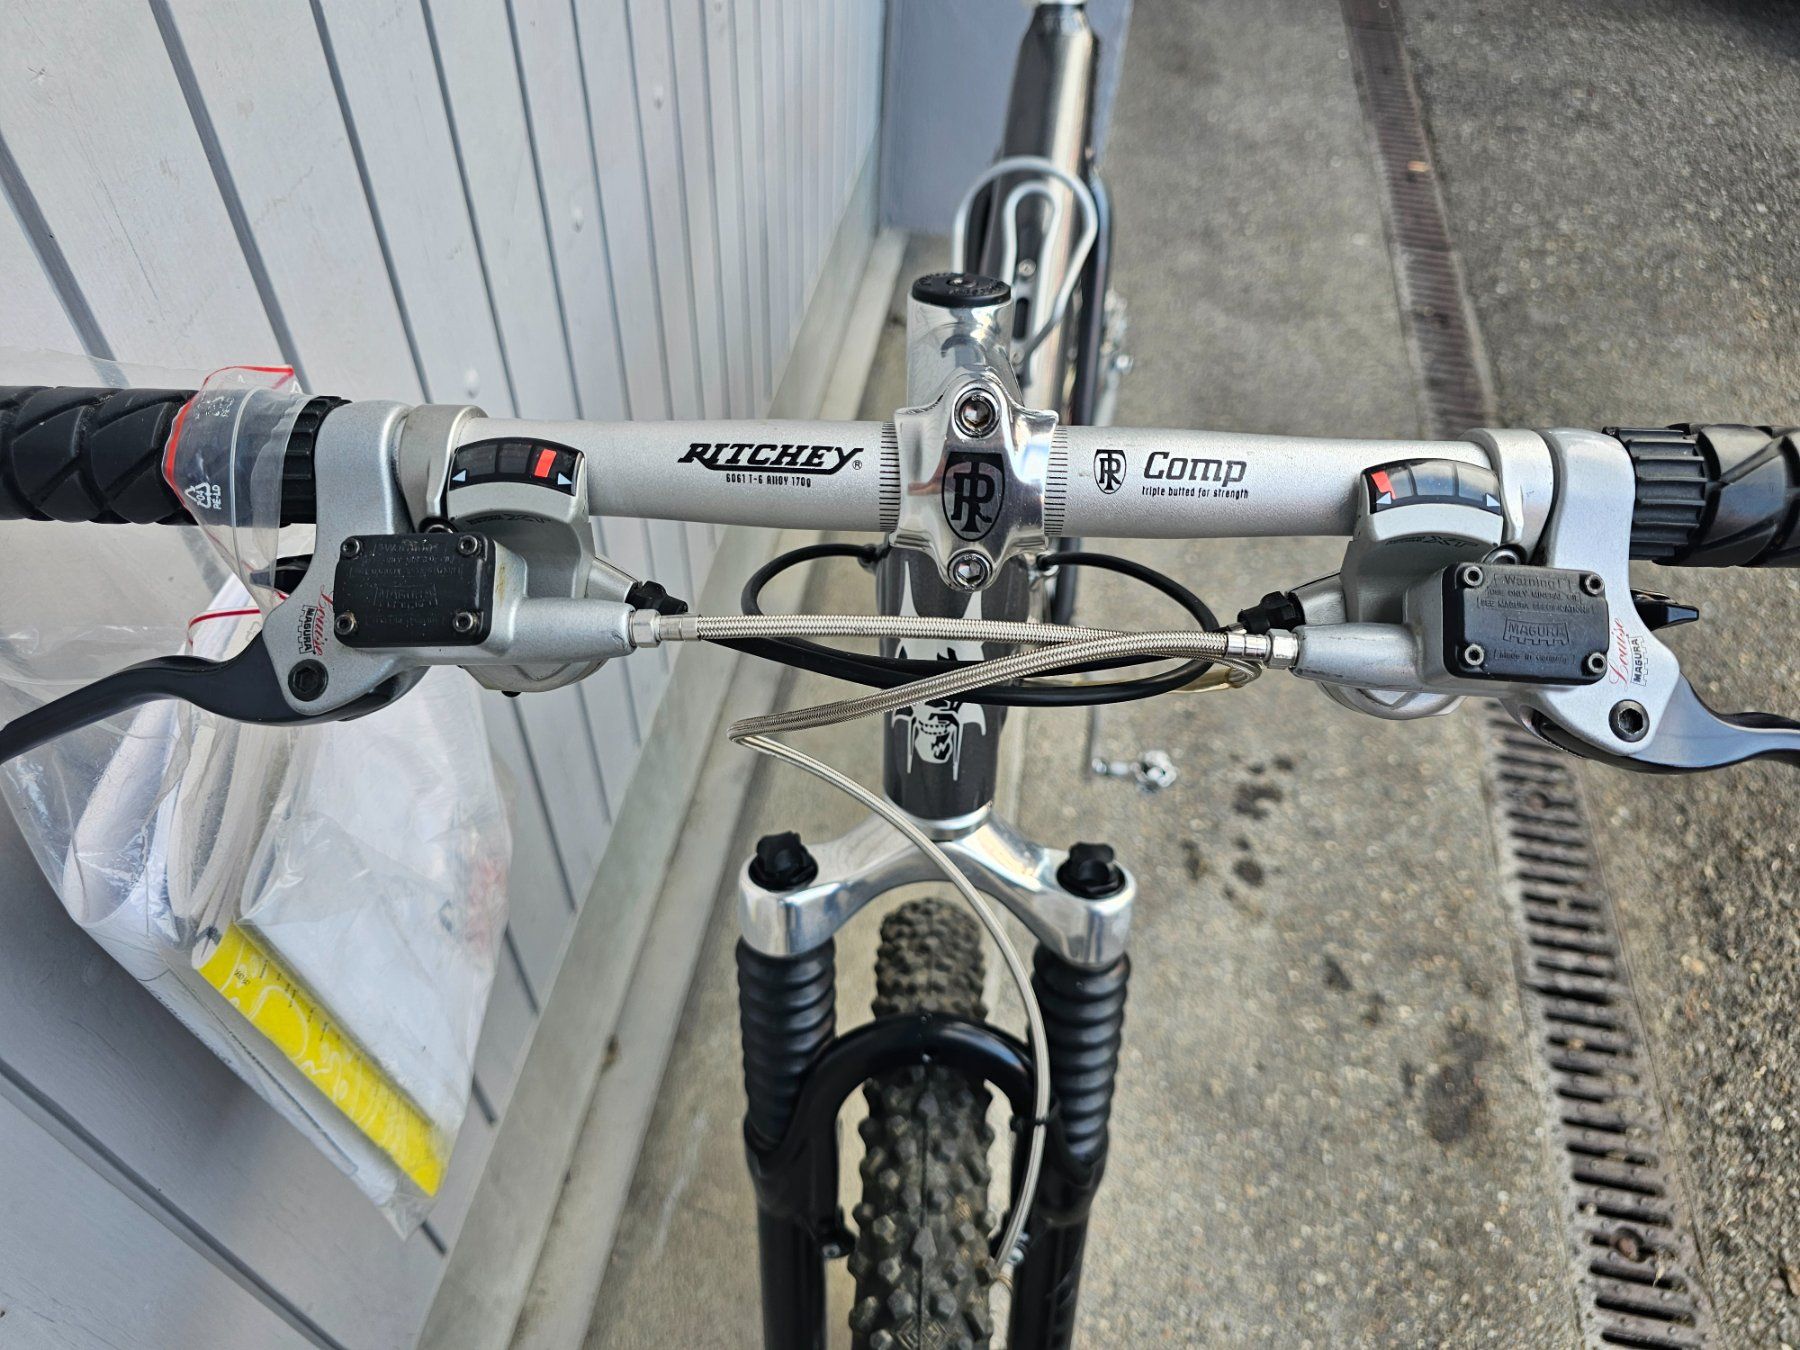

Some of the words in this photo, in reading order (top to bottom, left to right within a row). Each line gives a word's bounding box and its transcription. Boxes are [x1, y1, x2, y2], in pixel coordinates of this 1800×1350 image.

[678, 443, 864, 475] RITCHEY
[1143, 451, 1247, 487] Comp
[726, 473, 746, 484] 6061
[1142, 486, 1165, 498] triple
[1168, 486, 1195, 497] butted
[1197, 487, 1211, 499] for
[1213, 488, 1249, 500] strength
[212, 484, 222, 510] PE-LD
[302, 607, 316, 652] MAGURA
[1508, 621, 1566, 638] MAGURA
[1607, 617, 1629, 691] Louise
[1631, 638, 1643, 683] MAGURA
